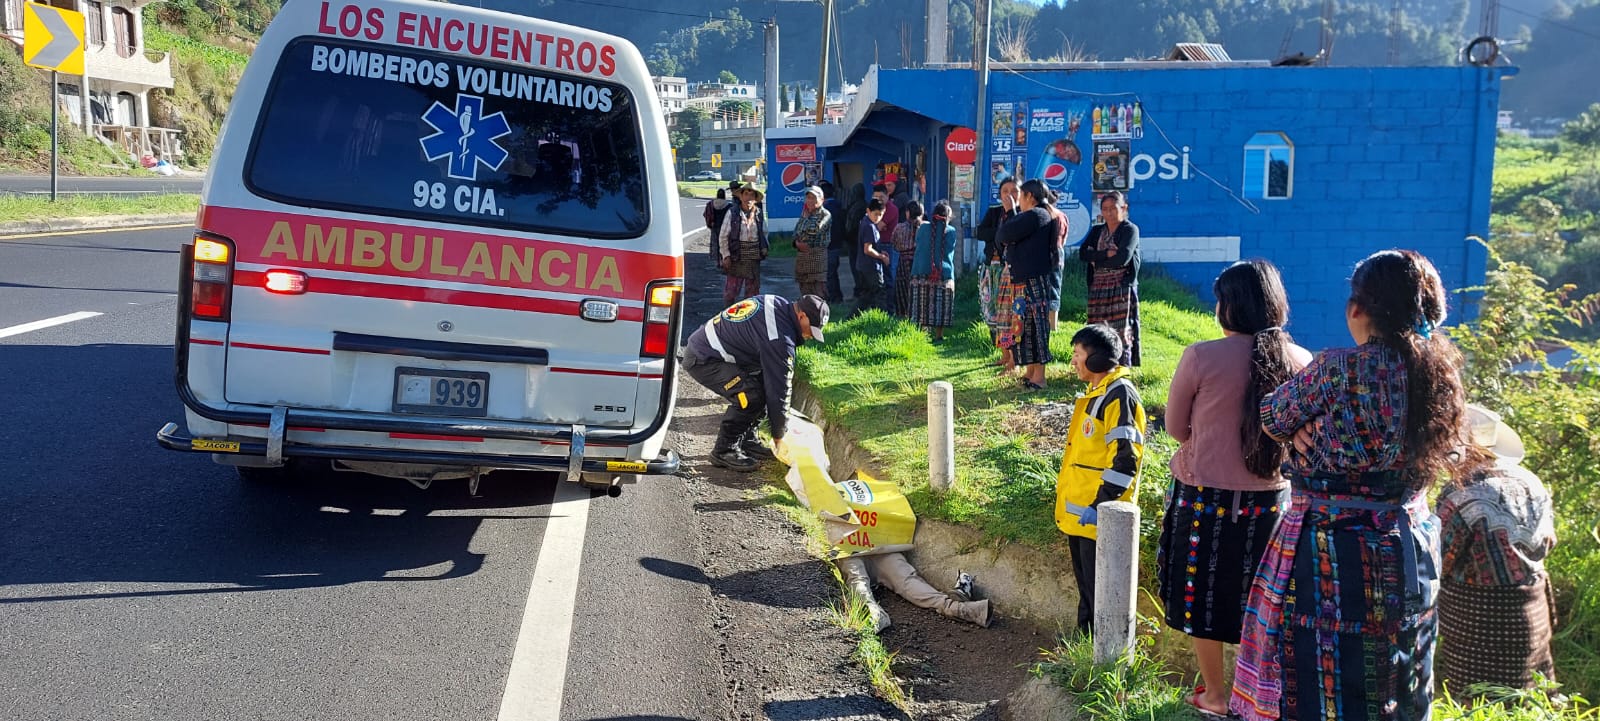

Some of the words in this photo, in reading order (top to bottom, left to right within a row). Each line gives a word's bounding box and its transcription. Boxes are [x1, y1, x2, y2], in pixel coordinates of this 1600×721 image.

[317, 1, 384, 40] LOS
[396, 11, 616, 77] ENCUENTROS
[311, 45, 450, 88] BOMBEROS
[457, 66, 613, 113] VOLUNTARIOS
[947, 140, 975, 151] Claro
[1129, 146, 1189, 189] psi
[413, 180, 447, 208] 98
[454, 184, 505, 217] CIA.
[259, 222, 624, 293] AMBULANCIA
[436, 379, 480, 407] 939
